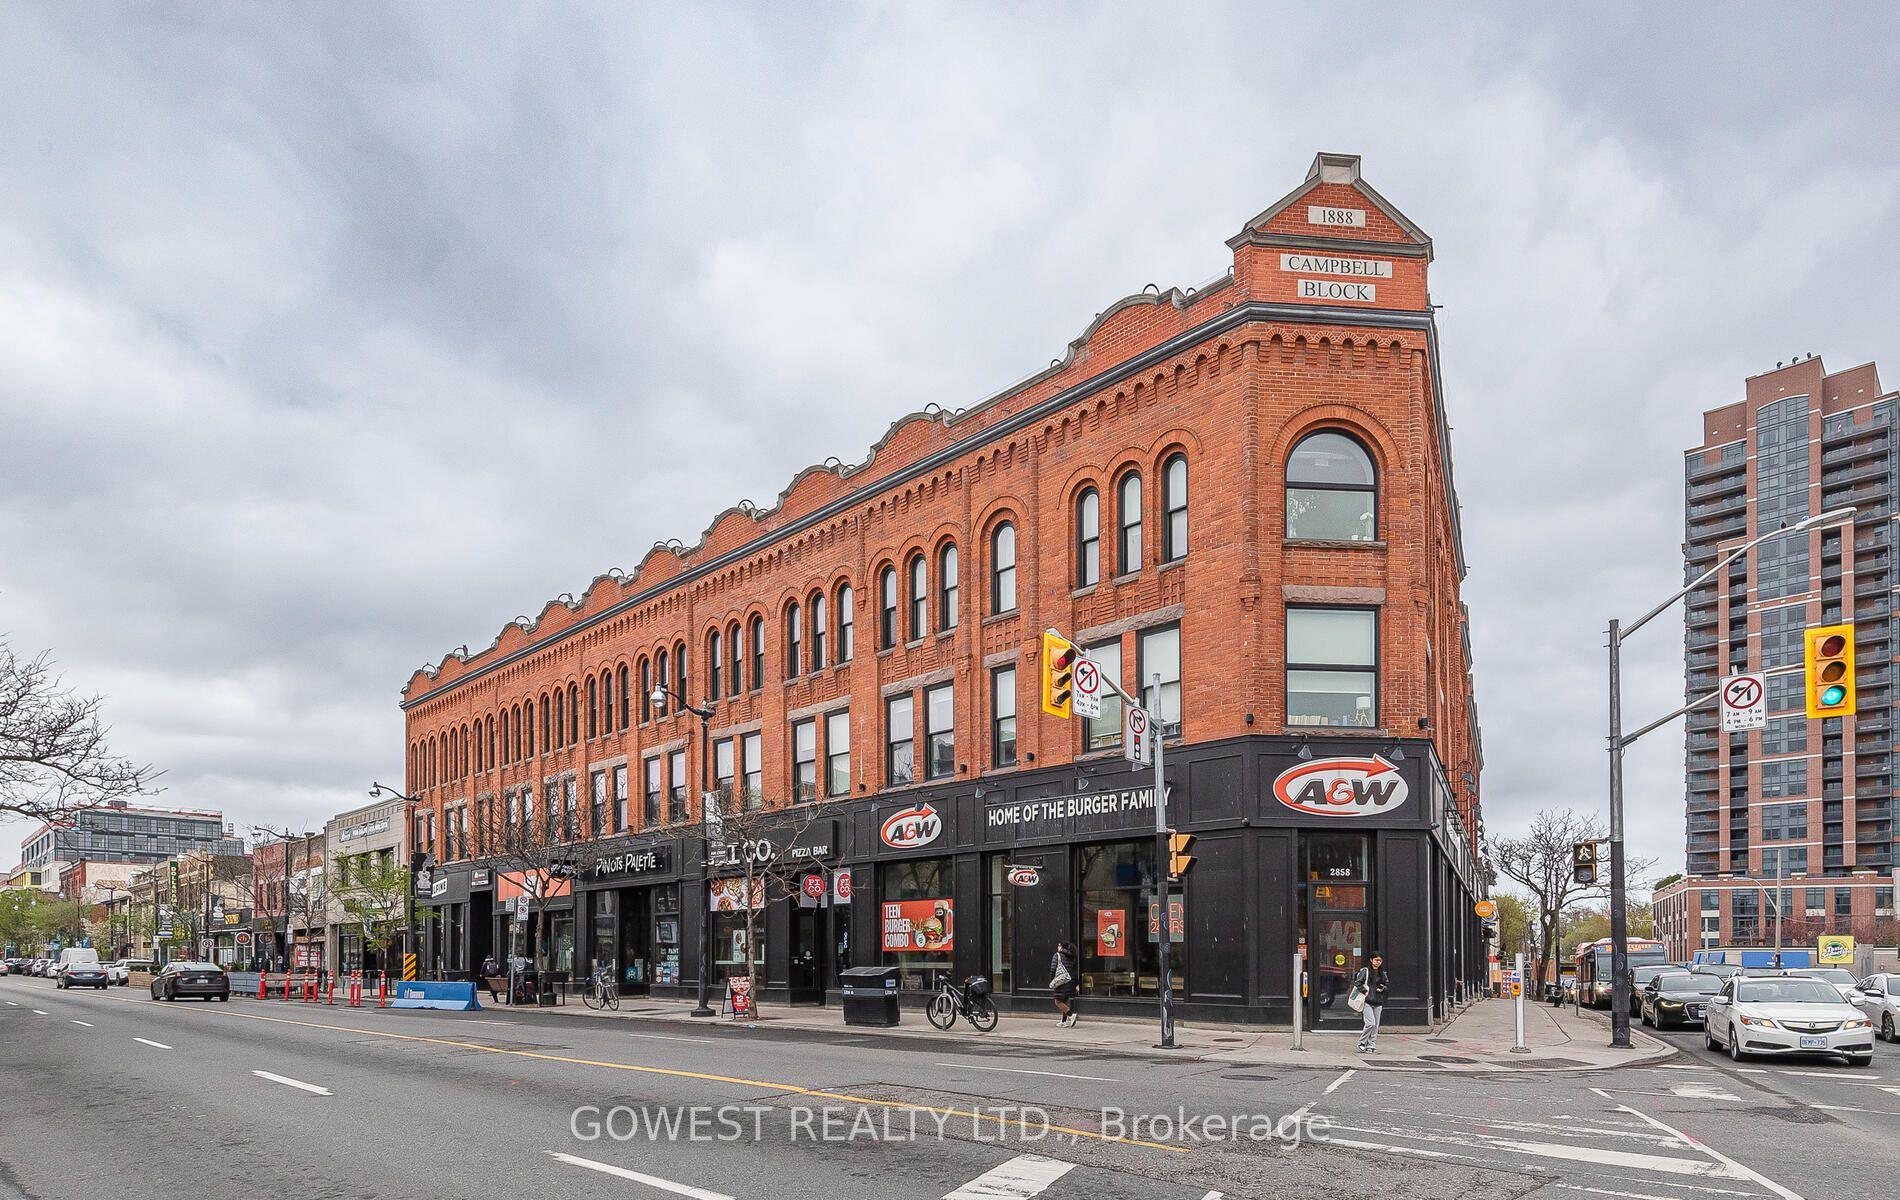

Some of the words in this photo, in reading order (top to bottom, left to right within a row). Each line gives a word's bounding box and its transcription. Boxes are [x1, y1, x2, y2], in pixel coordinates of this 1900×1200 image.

[1322, 209, 1353, 225] 1888
[1288, 256, 1385, 276] CAMPBELL
[1304, 281, 1370, 300] BLOCK
[1291, 778, 1399, 806] A&W
[988, 805, 1020, 827] HOME
[1022, 803, 1039, 823] OF
[1042, 800, 1065, 820] THE
[1067, 794, 1118, 818] BURGER
[890, 818, 938, 842] A&W
[791, 847, 812, 858] PIZZA
[813, 845, 828, 856] BAR
[625, 852, 656, 873] PALETTE
[1329, 868, 1351, 877] 2858
[809, 885, 823, 893] CO.
[840, 878, 850, 886] PI
[885, 904, 902, 918] TEEN
[1150, 903, 1184, 921] OEN
[885, 918, 911, 933] BURGER
[885, 933, 909, 948] COMBO
